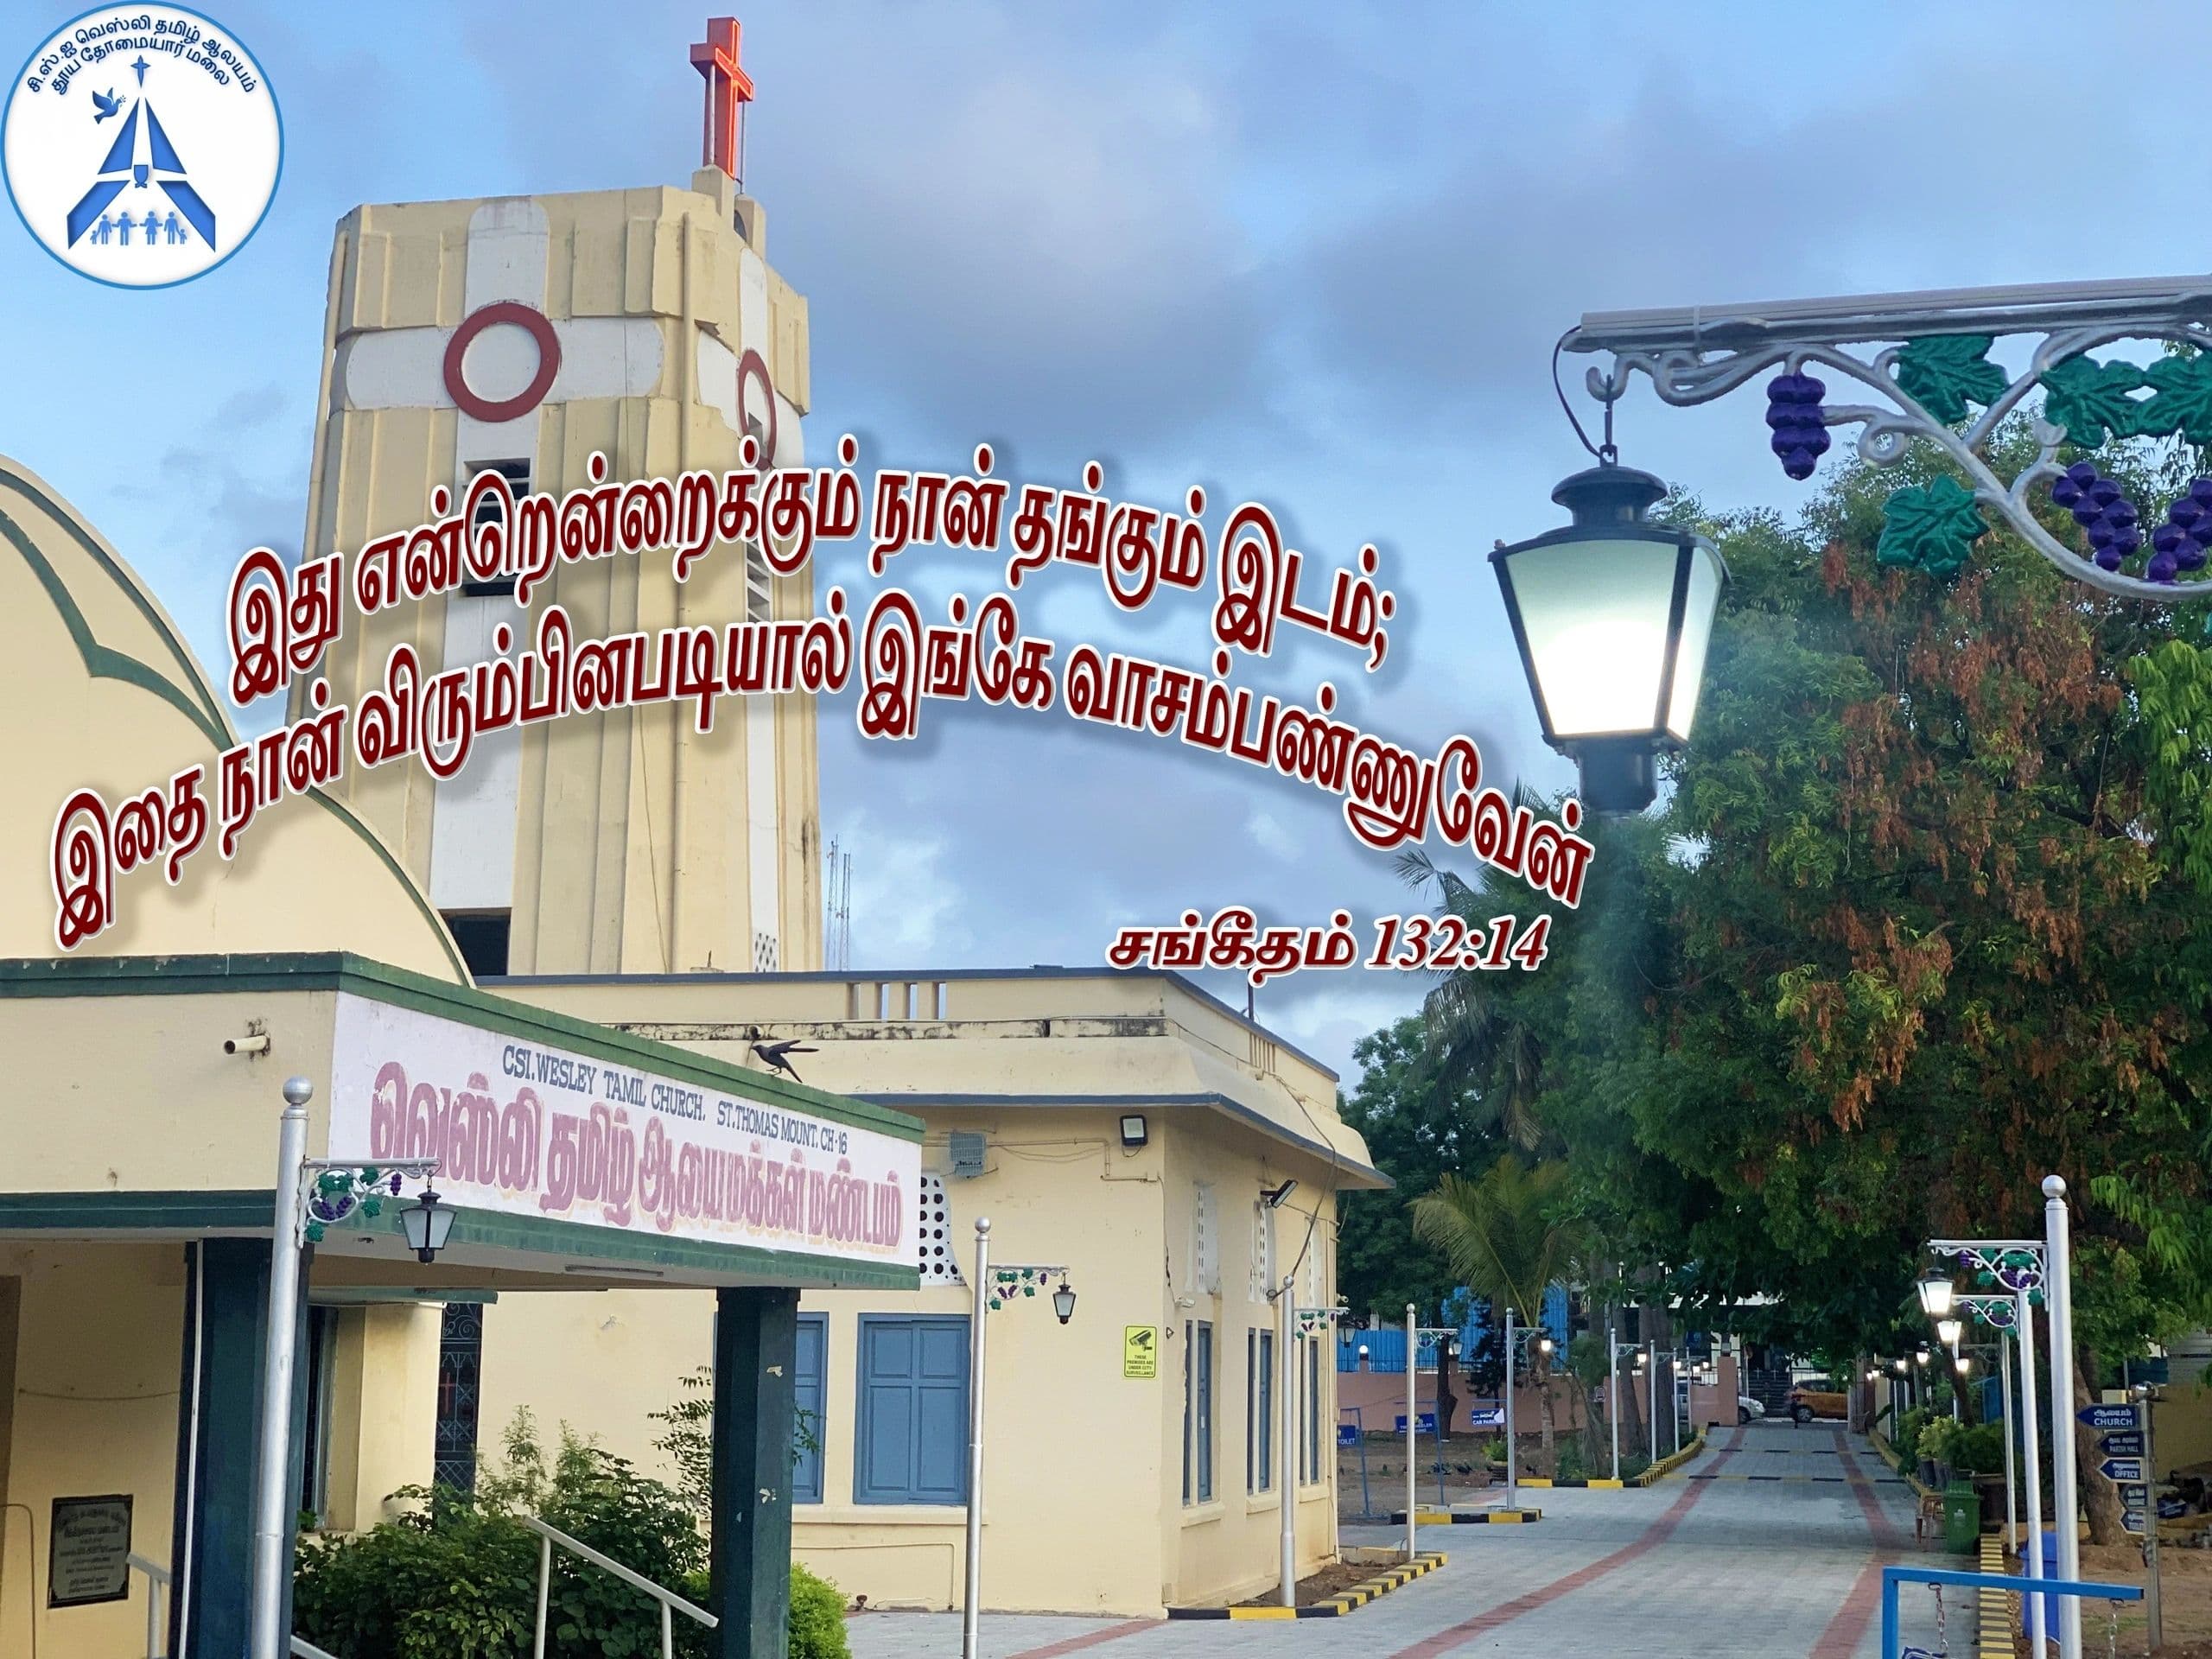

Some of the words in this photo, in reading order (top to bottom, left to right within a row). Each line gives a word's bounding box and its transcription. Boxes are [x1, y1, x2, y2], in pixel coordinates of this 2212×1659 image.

[370, 1061, 542, 1192] வெஸ்லி
[538, 1102, 635, 1227] தமிழ்
[808, 1157, 902, 1247] மண்டபம்
[604, 1071, 646, 1107] TAMIL
[652, 1084, 706, 1121] CHURCH.
[781, 1116, 818, 1148] MOUNT.
